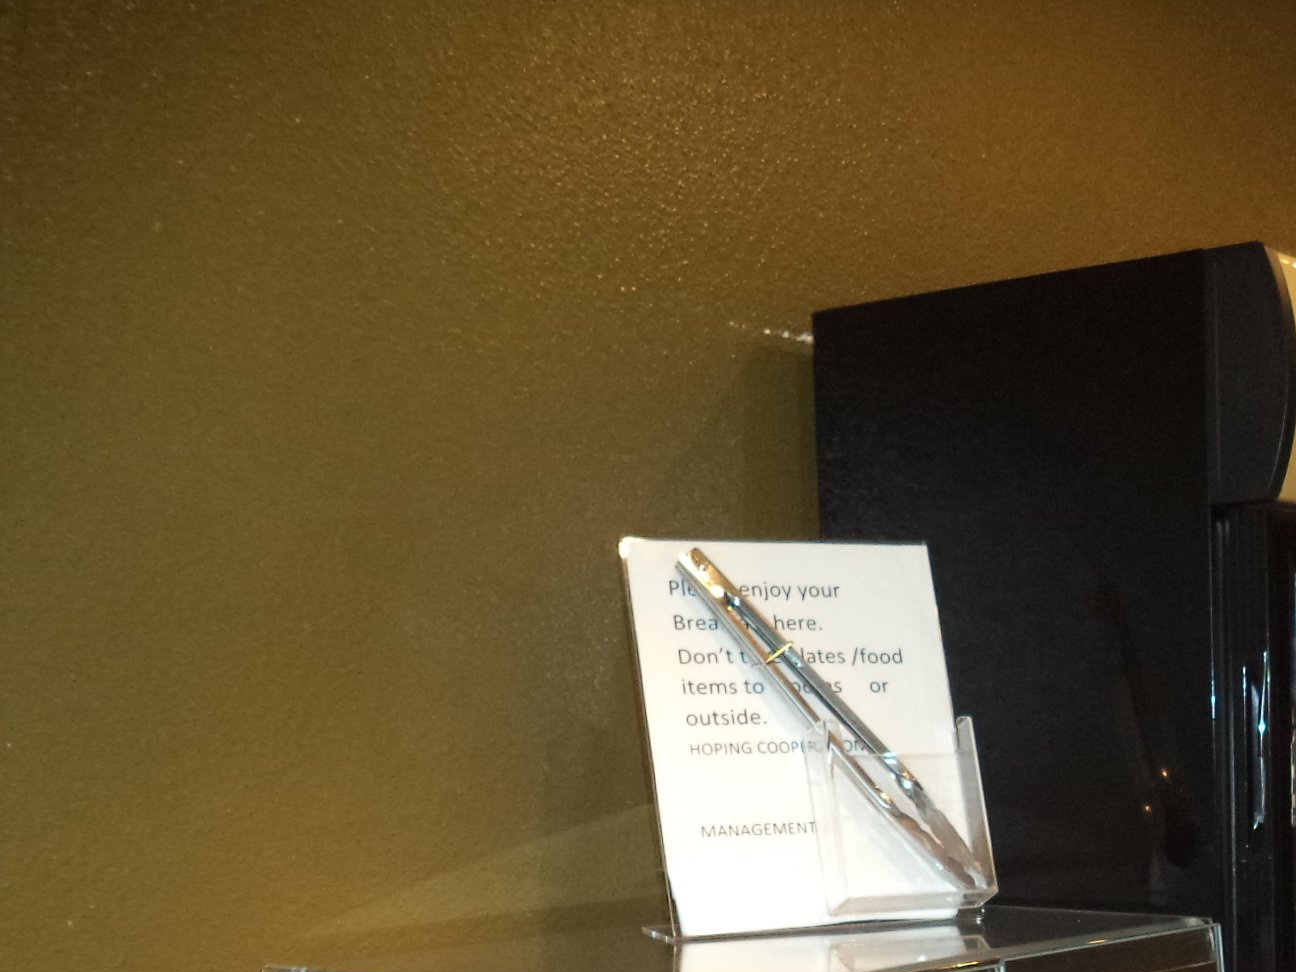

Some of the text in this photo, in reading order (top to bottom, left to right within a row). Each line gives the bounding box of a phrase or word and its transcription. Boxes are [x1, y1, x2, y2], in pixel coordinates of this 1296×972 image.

[739, 581, 791, 600] enjoy
[797, 584, 840, 600] your
[773, 614, 823, 631] here.
[799, 647, 846, 665] lates
[681, 679, 738, 695] items
[744, 679, 765, 695] to
[869, 680, 889, 694] or
[685, 709, 768, 726] outside.
[690, 742, 753, 756] HOPING
[701, 821, 817, 838] MANAGEMENT
